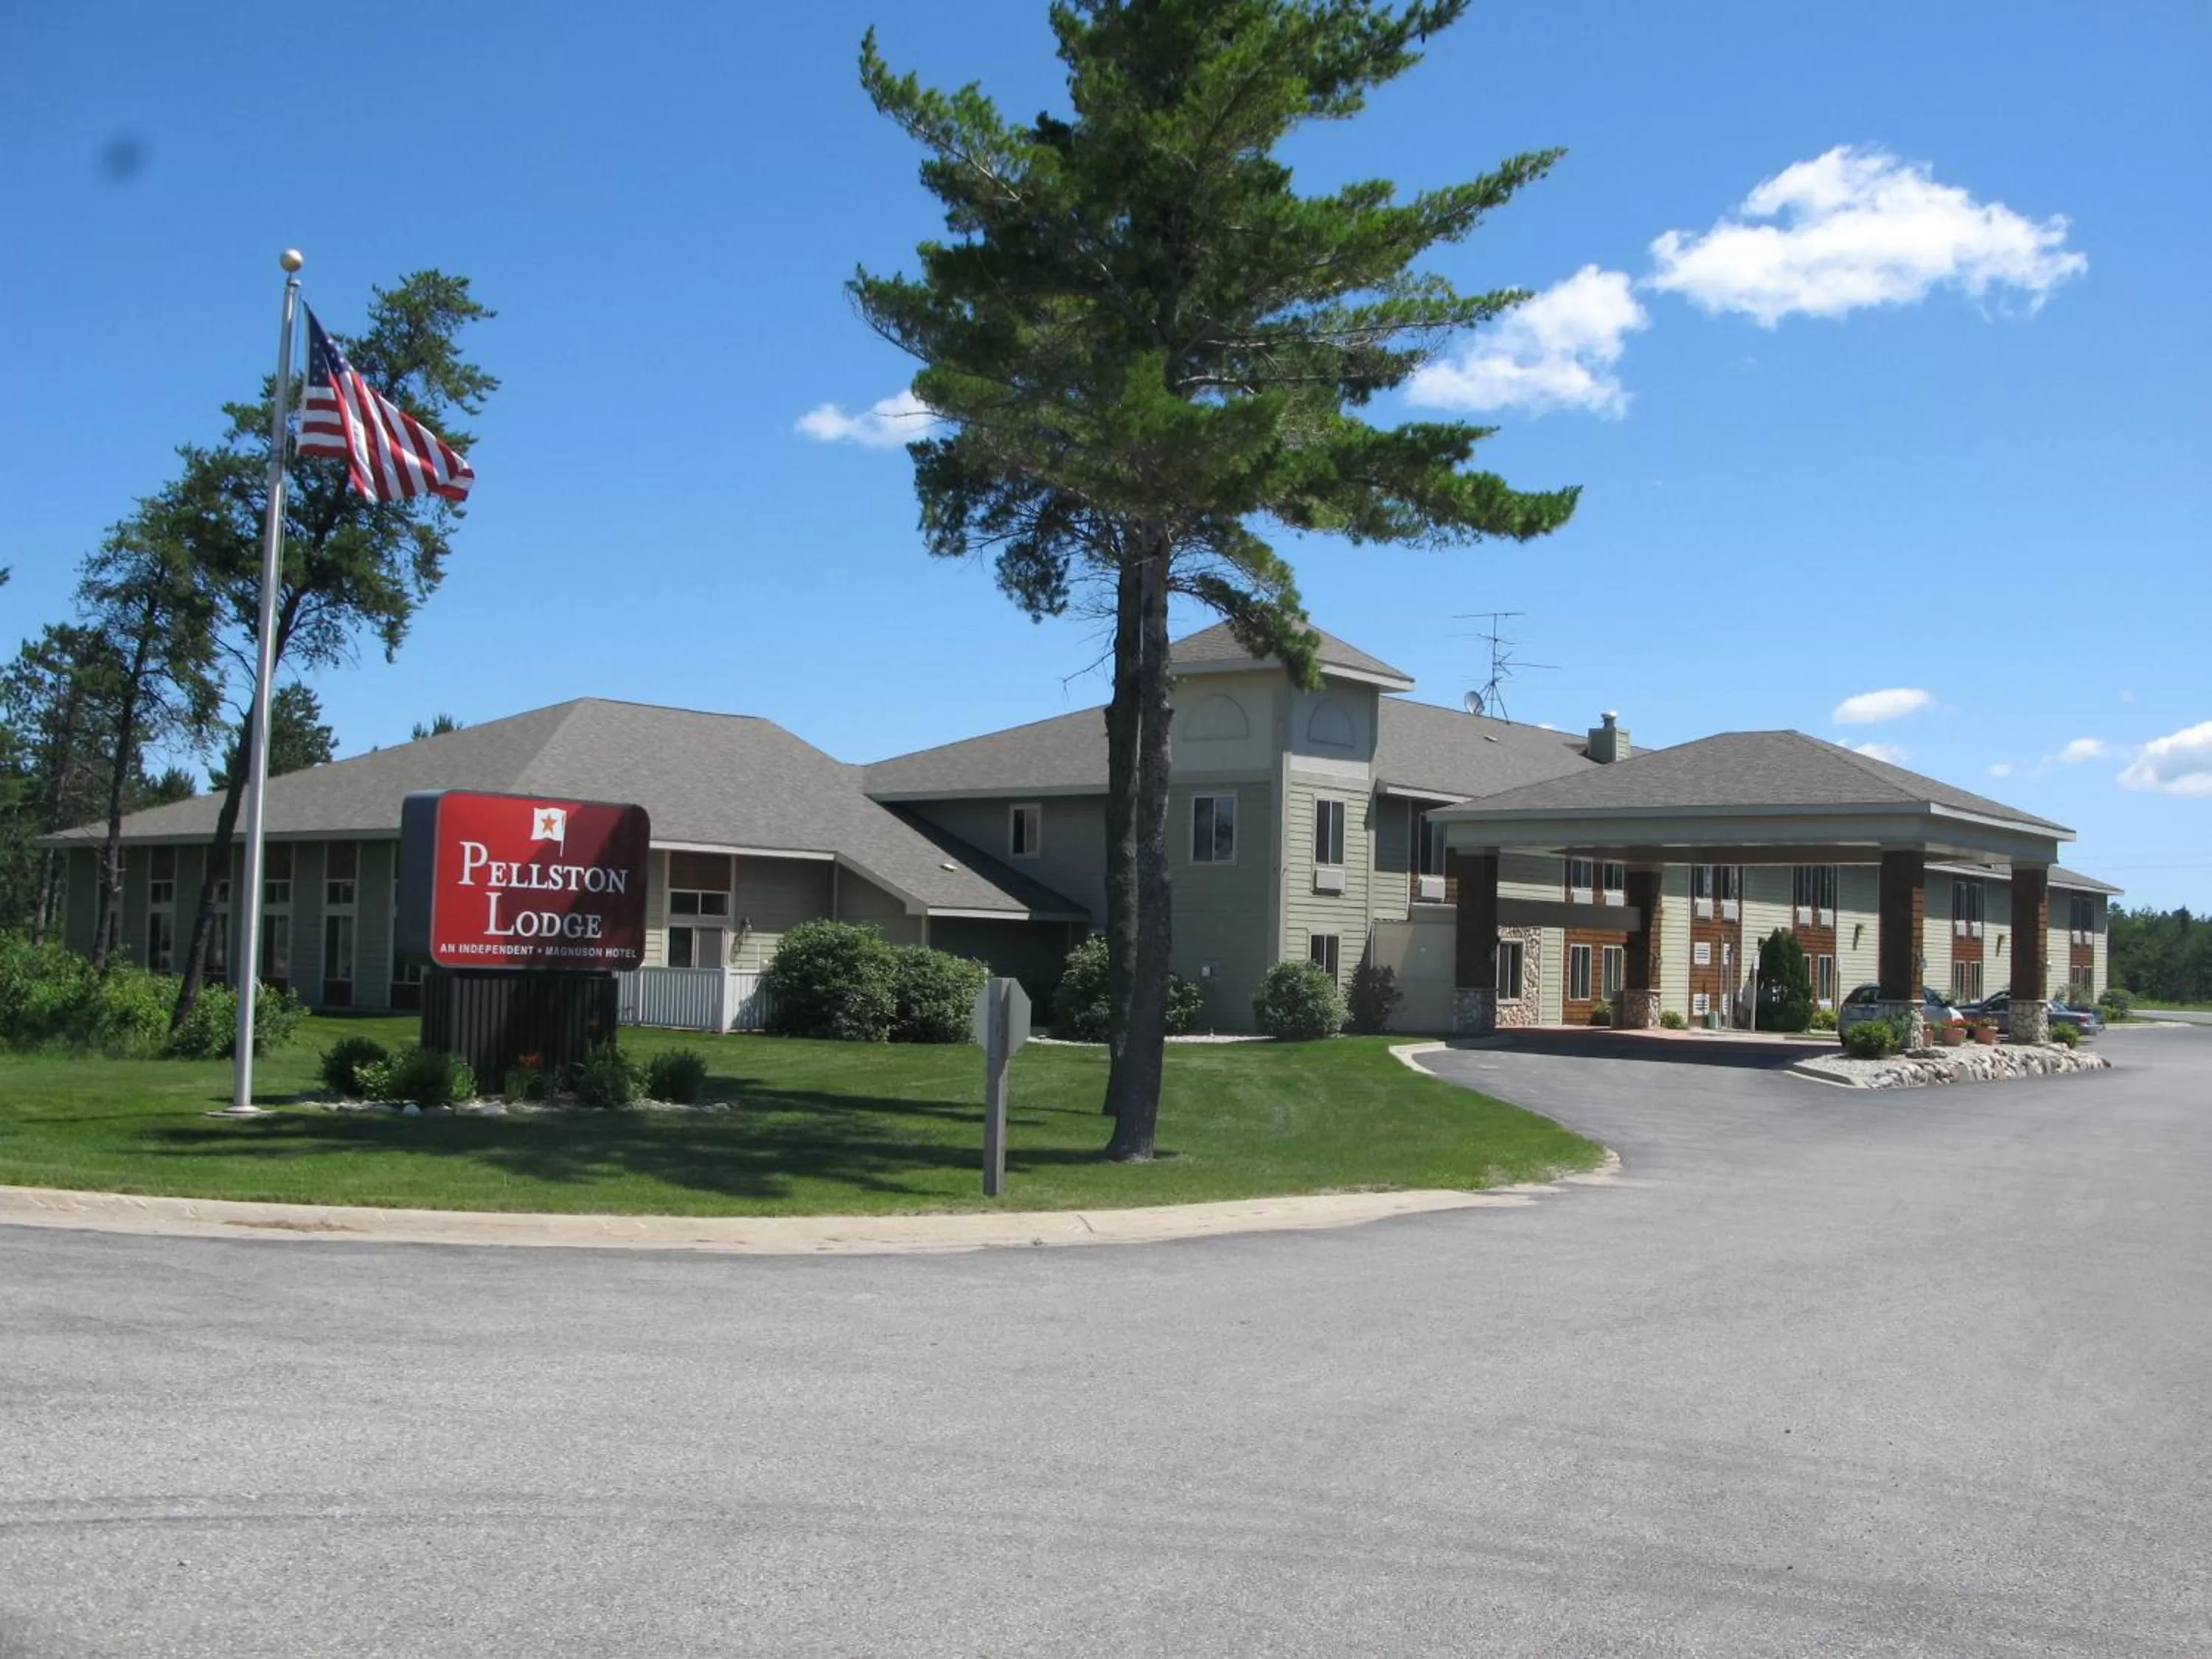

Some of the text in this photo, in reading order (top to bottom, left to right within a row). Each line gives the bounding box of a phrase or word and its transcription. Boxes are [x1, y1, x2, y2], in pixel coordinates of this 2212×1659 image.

[457, 841, 628, 894] PELLSTON
[484, 891, 602, 939] LODGE
[440, 943, 637, 959] AN INDEPENDENT MAGNUSON HOTEL
